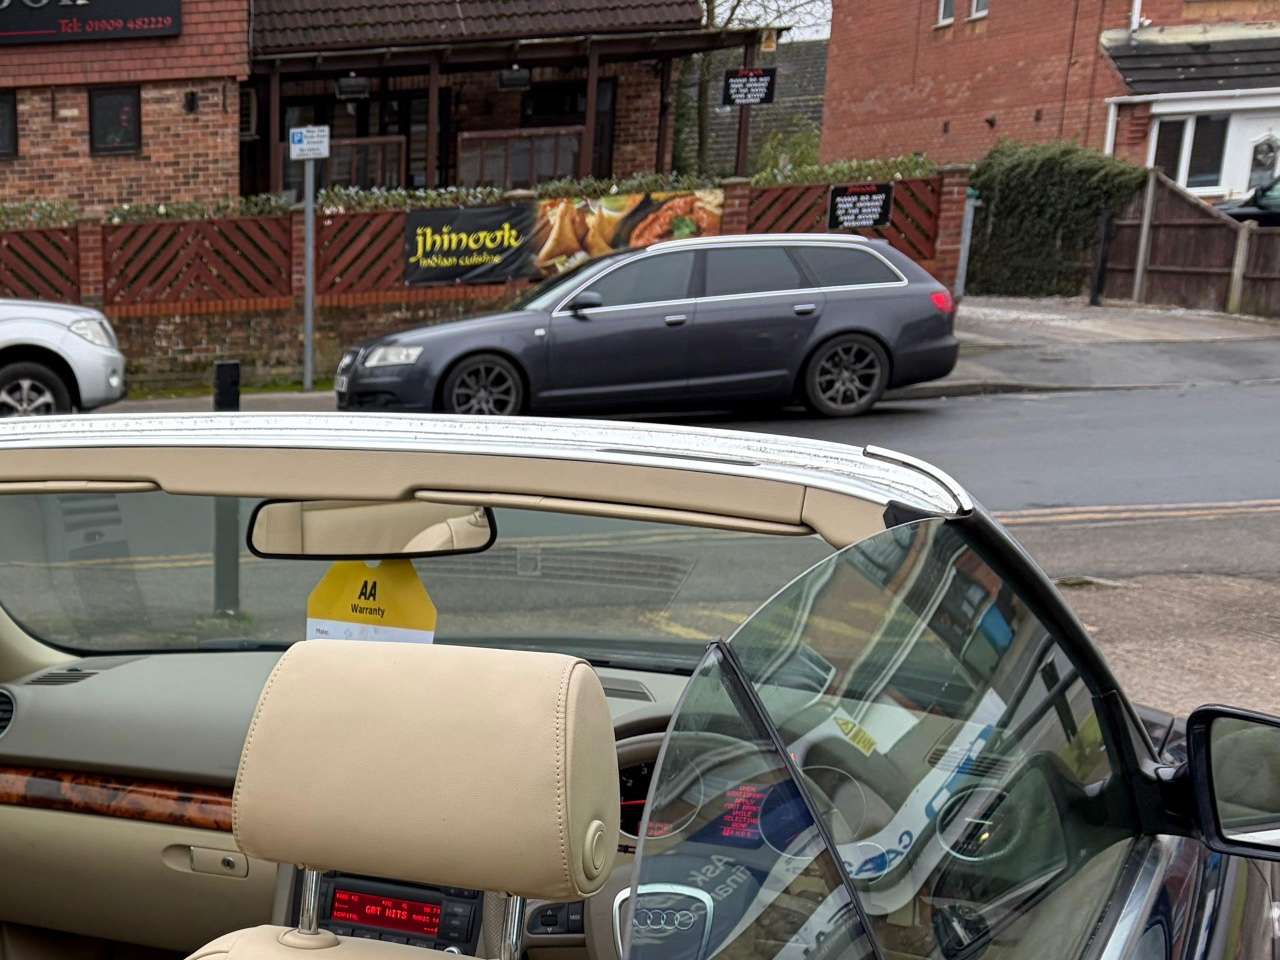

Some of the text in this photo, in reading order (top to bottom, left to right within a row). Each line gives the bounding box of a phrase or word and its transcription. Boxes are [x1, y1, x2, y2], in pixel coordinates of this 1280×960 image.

[85, 19, 124, 32] 01909
[408, 222, 524, 264] jhinook
[358, 580, 377, 601] AA
[350, 603, 385, 618] Warranty
[385, 908, 408, 920] HITS
